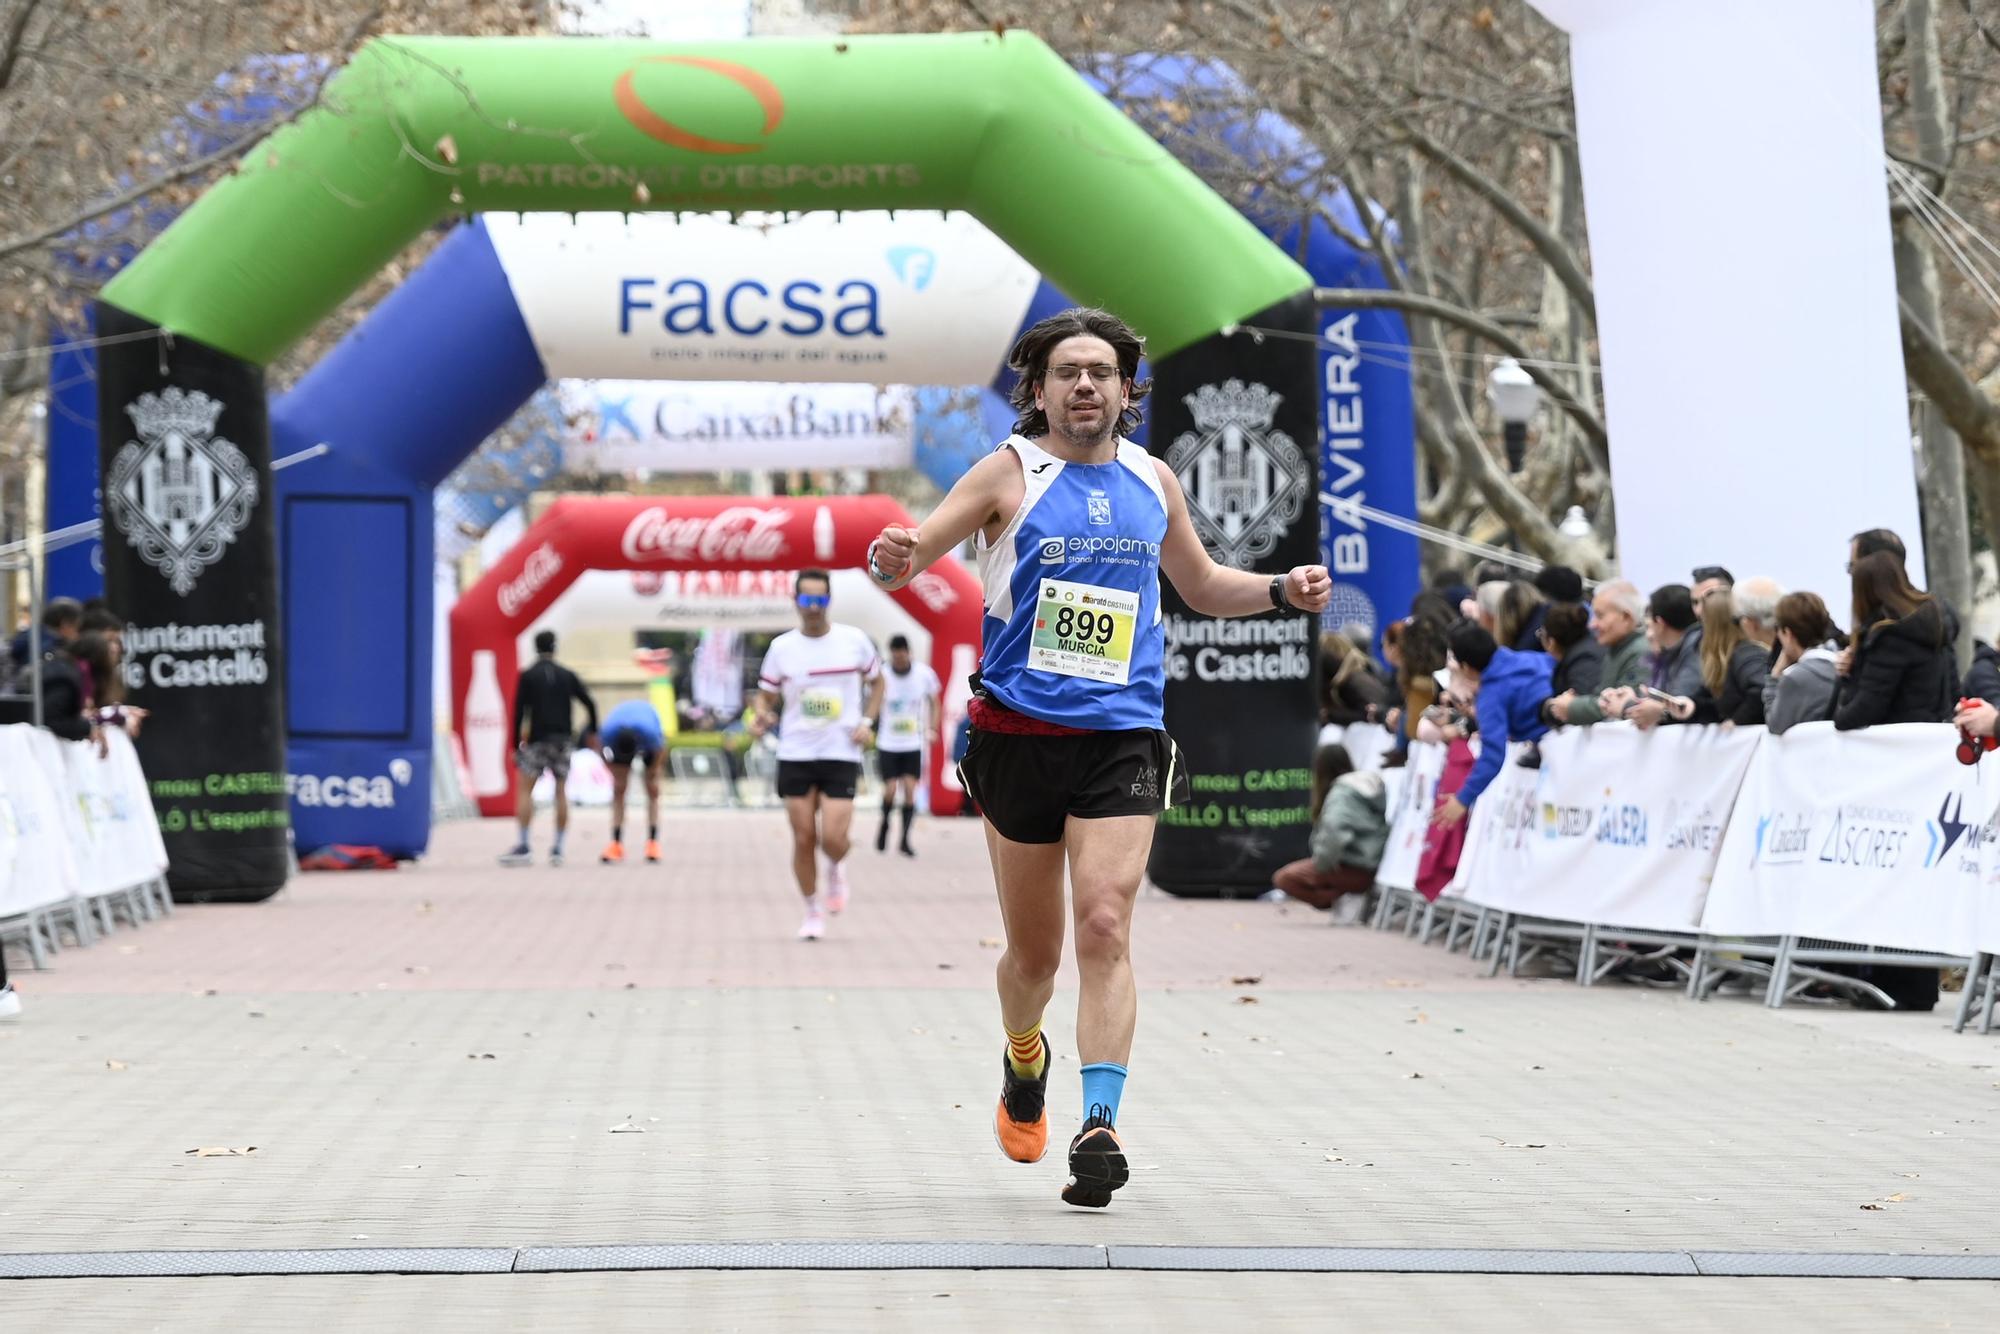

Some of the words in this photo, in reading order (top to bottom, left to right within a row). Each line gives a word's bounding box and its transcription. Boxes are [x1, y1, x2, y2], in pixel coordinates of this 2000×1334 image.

[477, 162, 689, 189] PATRONAT
[701, 162, 922, 189] D'ESPORTS
[1324, 311, 1369, 574] BAVIERA
[1068, 534, 1160, 556] expojama
[121, 618, 266, 662] juntament
[1055, 606, 1115, 645] 899
[1057, 639, 1106, 657] MURCIA
[1194, 644, 1311, 682] Castelló
[150, 649, 269, 689] Castelló
[1192, 774, 1241, 792] mou
